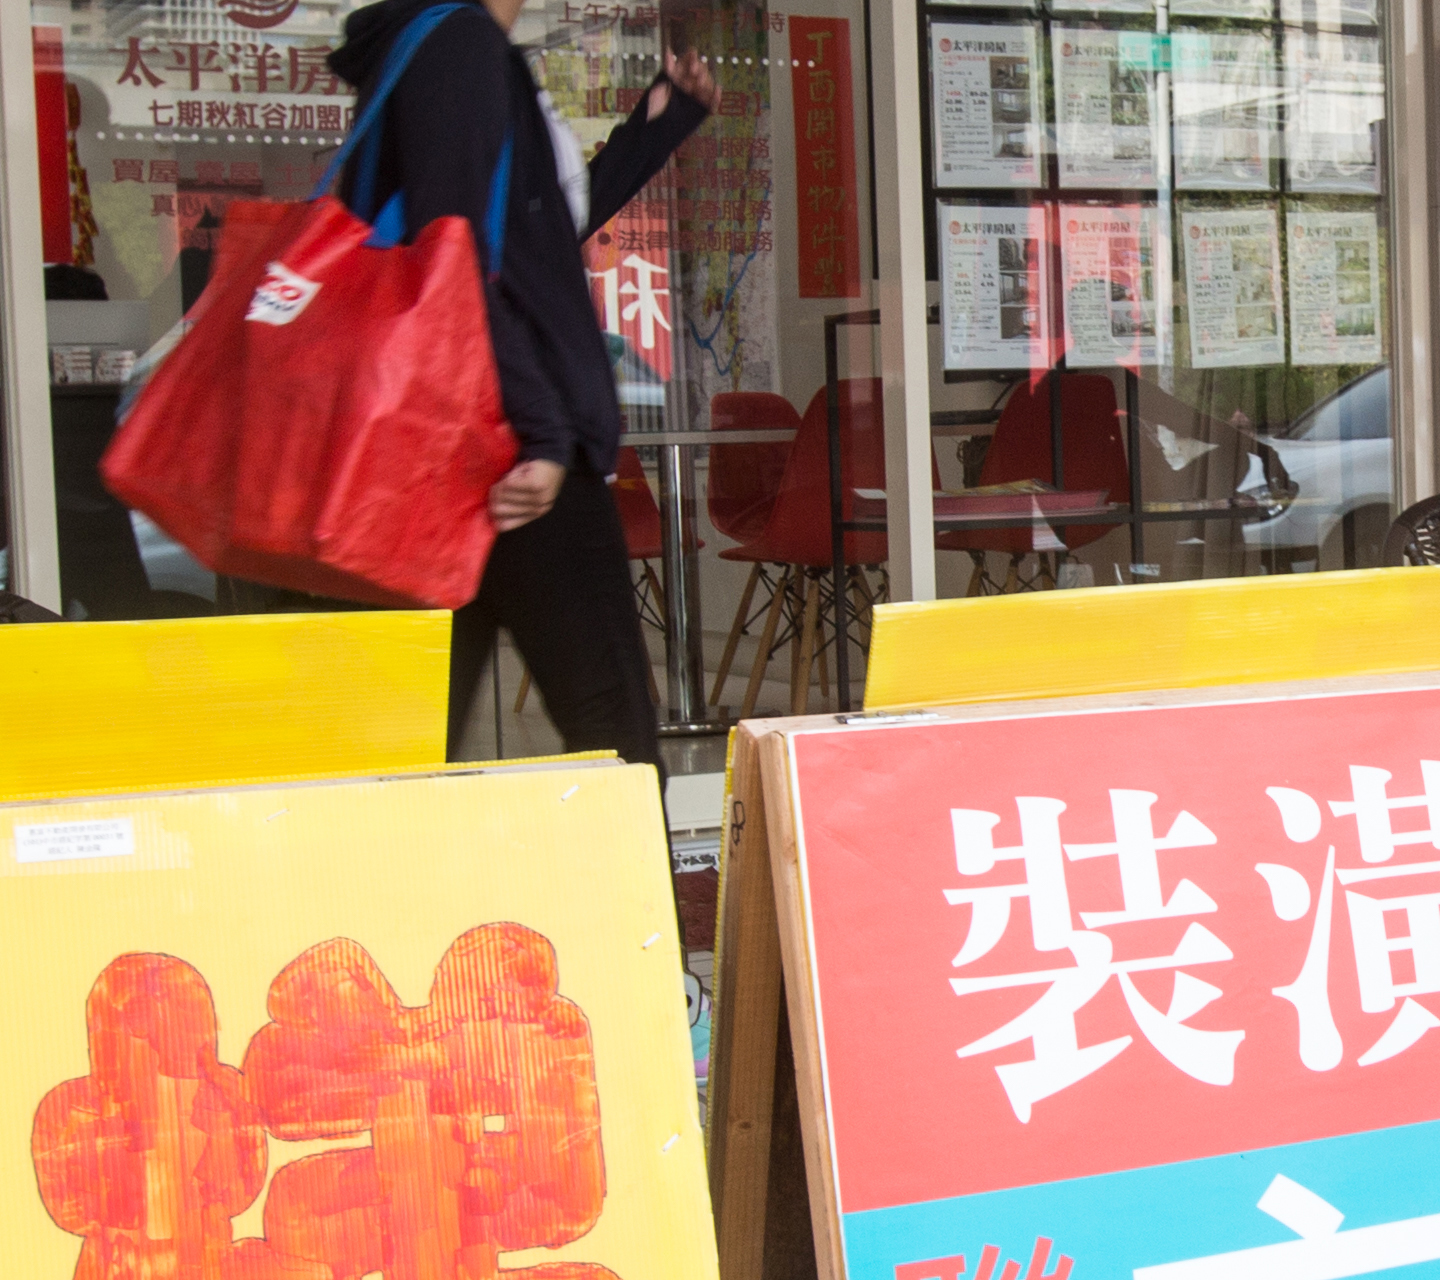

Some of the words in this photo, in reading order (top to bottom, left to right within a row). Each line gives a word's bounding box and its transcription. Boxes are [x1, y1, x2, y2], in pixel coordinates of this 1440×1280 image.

[109, 36, 357, 95] 太平洋房
[111, 158, 180, 184] 買屋
